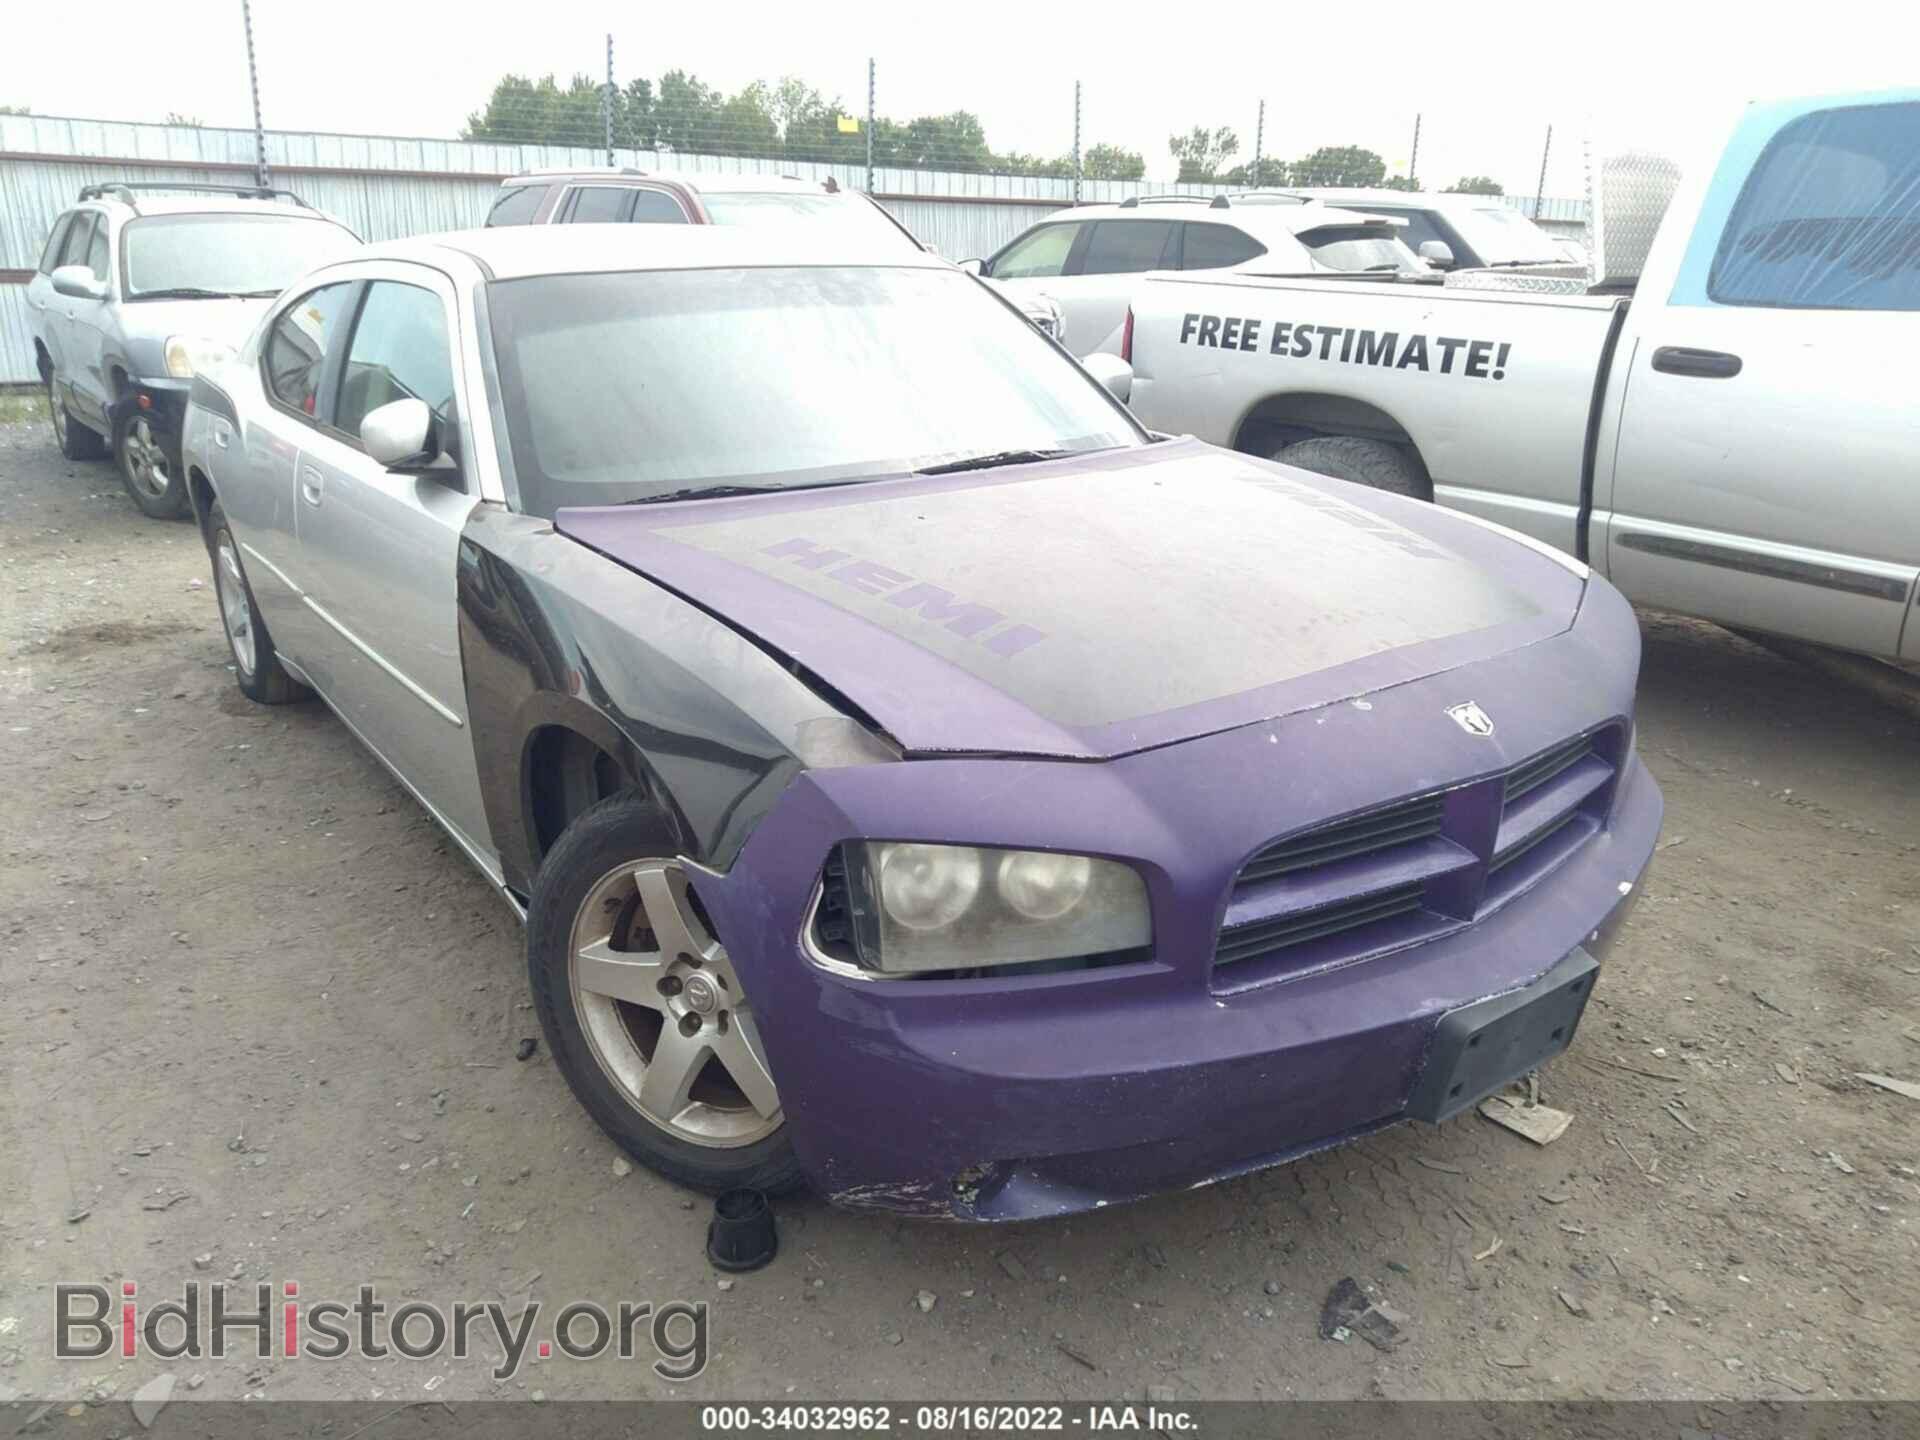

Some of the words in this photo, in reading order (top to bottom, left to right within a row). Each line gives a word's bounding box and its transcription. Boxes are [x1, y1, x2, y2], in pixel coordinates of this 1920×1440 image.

[1179, 312, 1262, 353] FREE
[1269, 321, 1512, 381] ESTIMATE!
[758, 537, 1048, 656] HEMI
